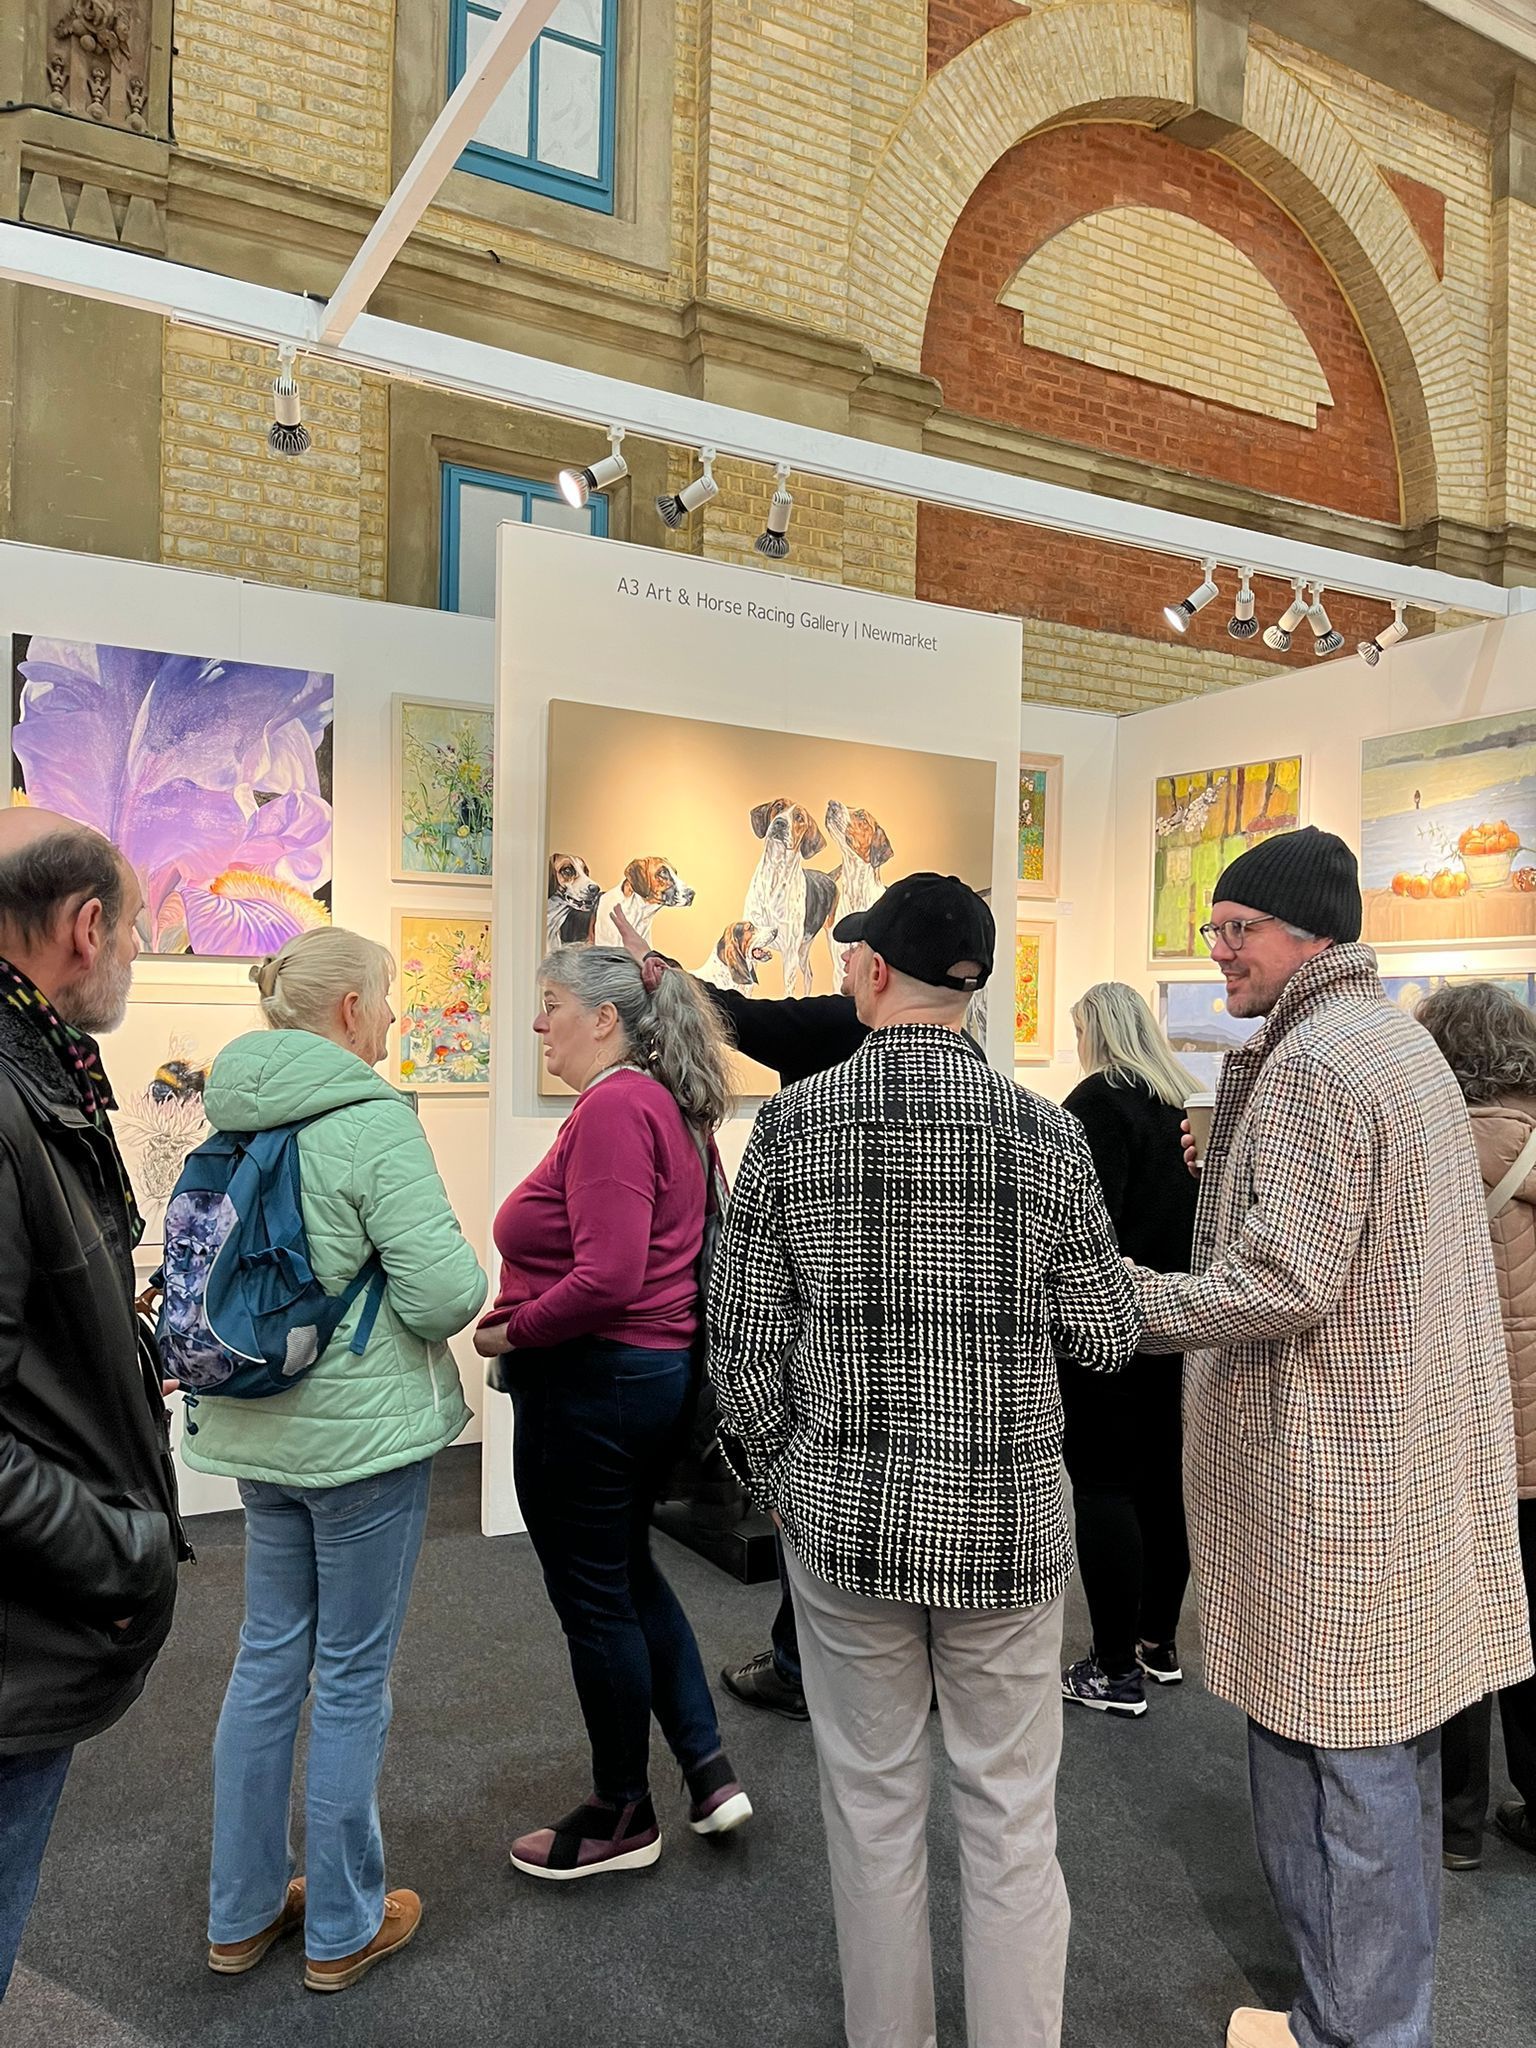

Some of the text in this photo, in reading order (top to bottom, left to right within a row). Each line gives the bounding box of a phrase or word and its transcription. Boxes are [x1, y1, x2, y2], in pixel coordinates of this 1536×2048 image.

[616, 576, 640, 596] A3
[645, 582, 672, 603] Art
[677, 587, 691, 607] &
[696, 591, 742, 616] Horse
[747, 601, 795, 629] Racing
[800, 611, 850, 638] Gallery
[861, 622, 938, 652] Newmarket
